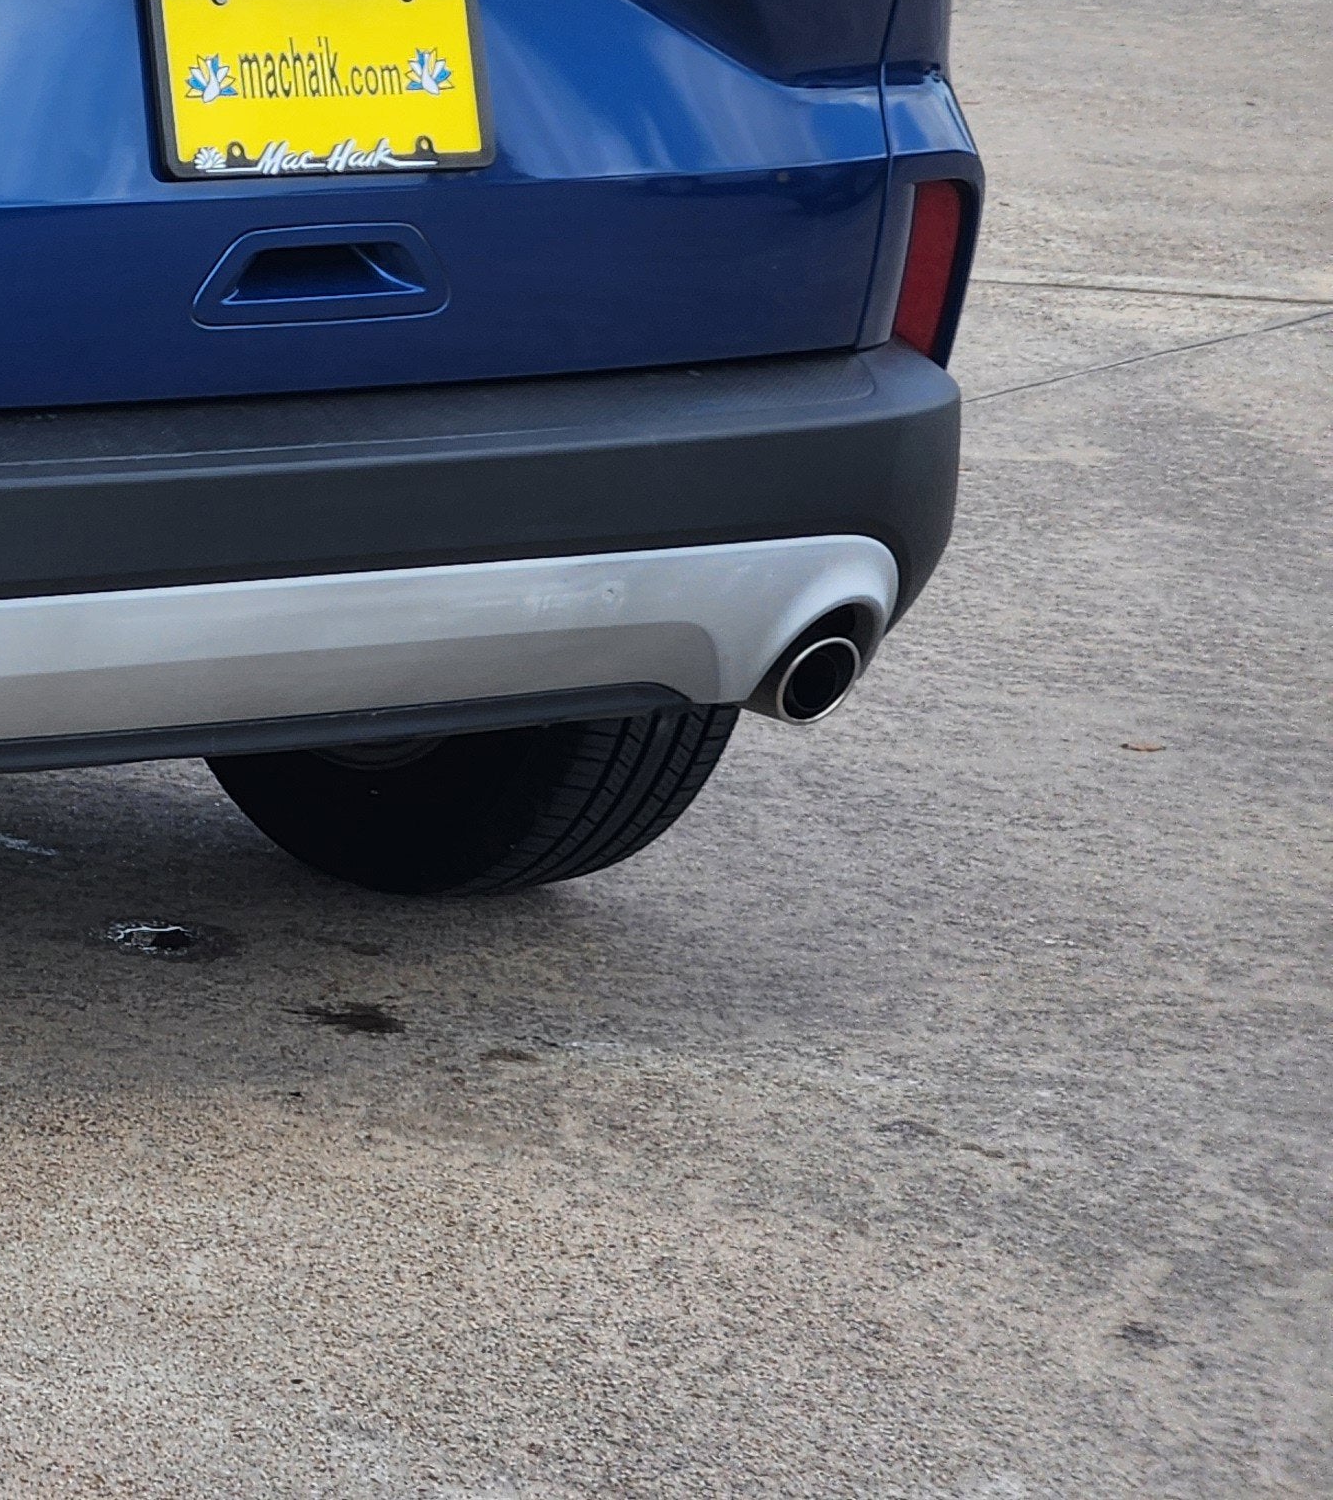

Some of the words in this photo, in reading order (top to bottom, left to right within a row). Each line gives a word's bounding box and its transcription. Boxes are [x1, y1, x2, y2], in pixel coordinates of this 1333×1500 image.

[238, 36, 404, 99] machaik.com
[255, 141, 324, 175] Mac
[324, 138, 405, 172] Haik
